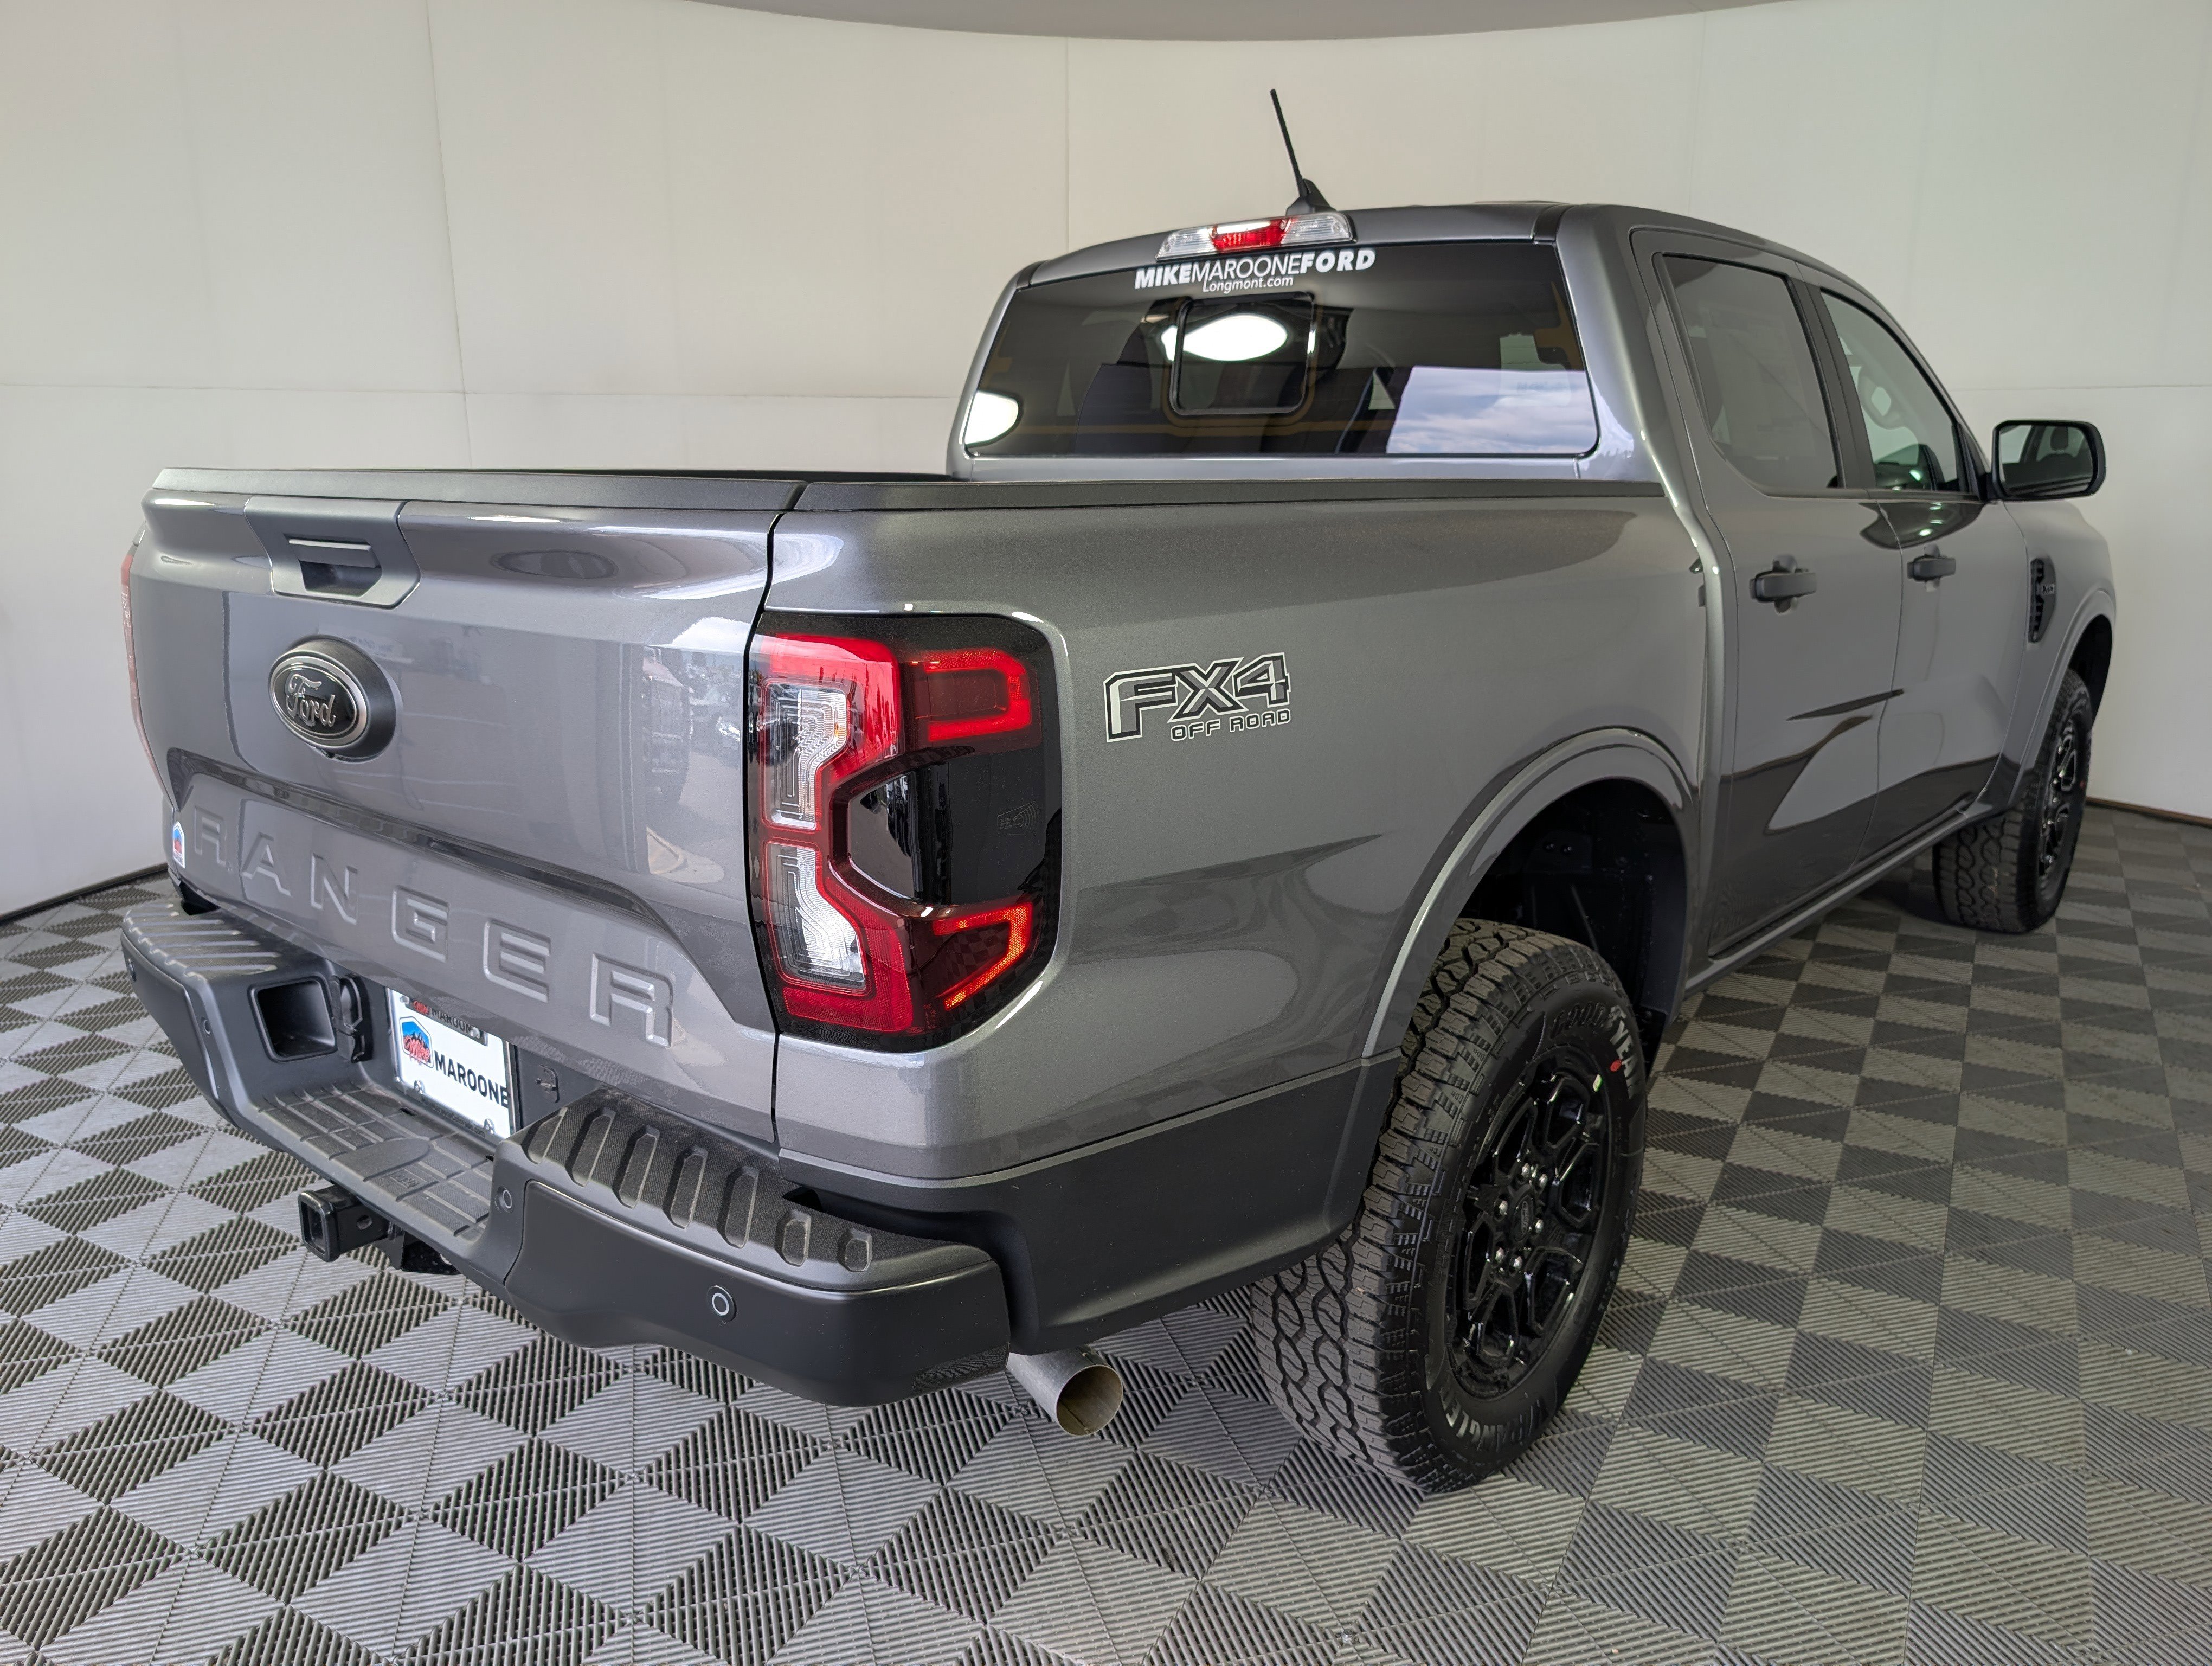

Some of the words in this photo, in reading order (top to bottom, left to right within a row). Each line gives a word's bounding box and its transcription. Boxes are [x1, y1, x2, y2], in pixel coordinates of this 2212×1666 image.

[1203, 276, 1294, 293] Longmont.com
[285, 673, 336, 727] Ford
[1103, 652, 1291, 742] FX4
[1172, 721, 1221, 741] OFF
[1230, 708, 1291, 732] ROAD
[194, 806, 673, 1047] RANGER
[432, 1009, 479, 1036] MAROON
[434, 1050, 510, 1108] MAROONE
